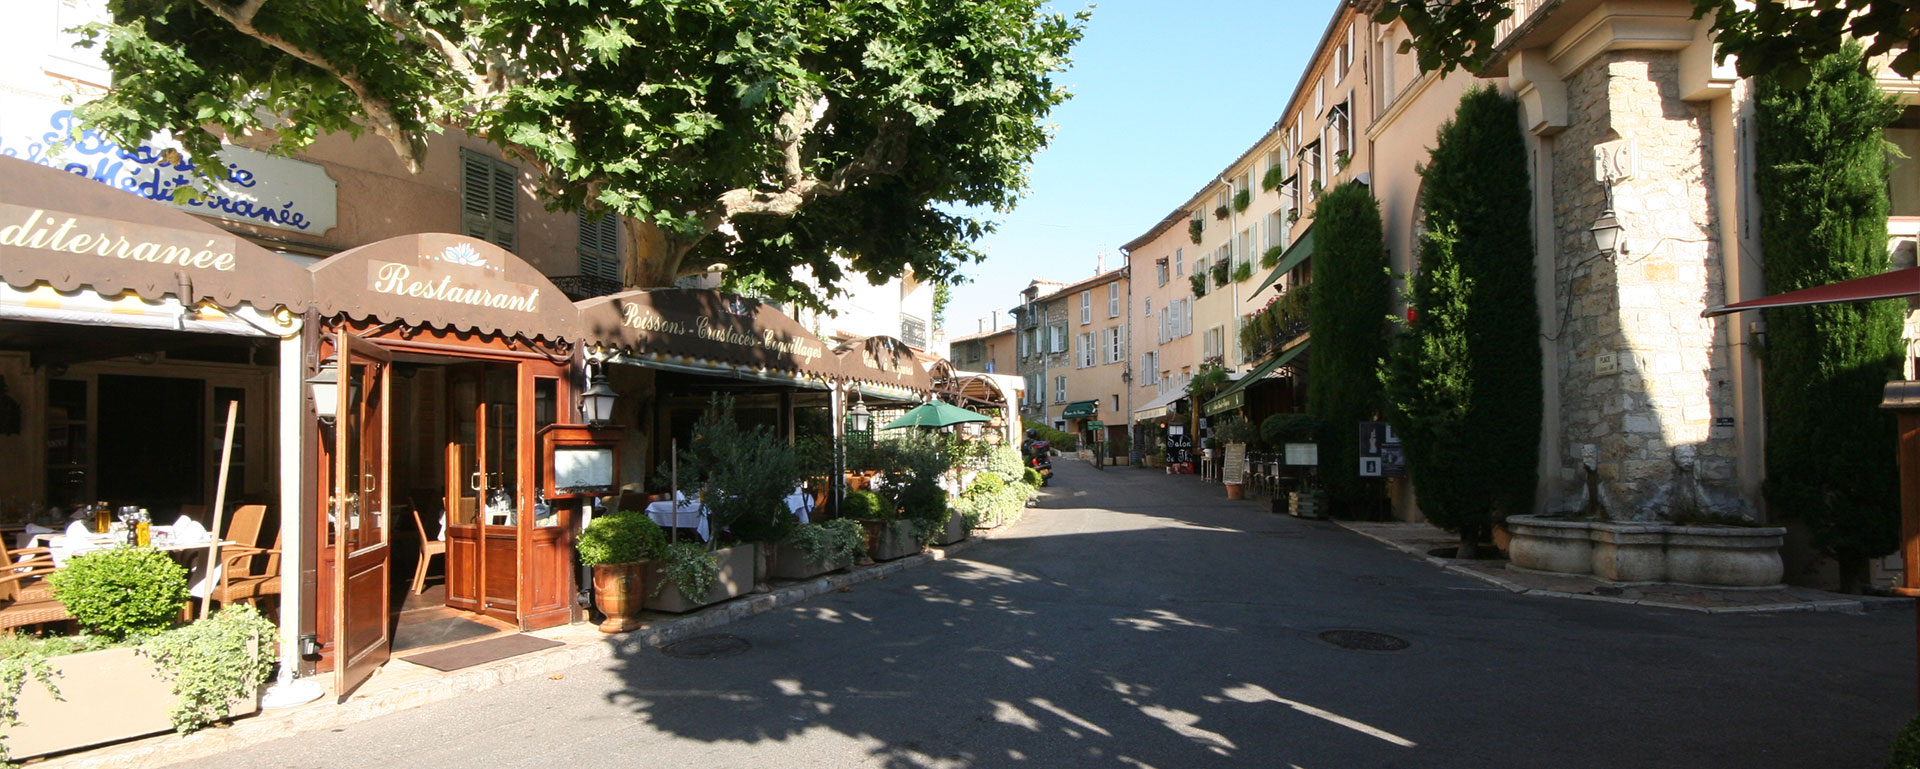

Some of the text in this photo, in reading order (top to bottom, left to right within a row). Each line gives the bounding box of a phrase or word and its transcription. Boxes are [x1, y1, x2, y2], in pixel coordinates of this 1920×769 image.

[375, 263, 540, 312] Restaurant
[622, 302, 685, 336] Poissons
[696, 315, 756, 347] Crustacés
[763, 328, 822, 364] Coquillages
[1167, 435, 1192, 448] Salon
